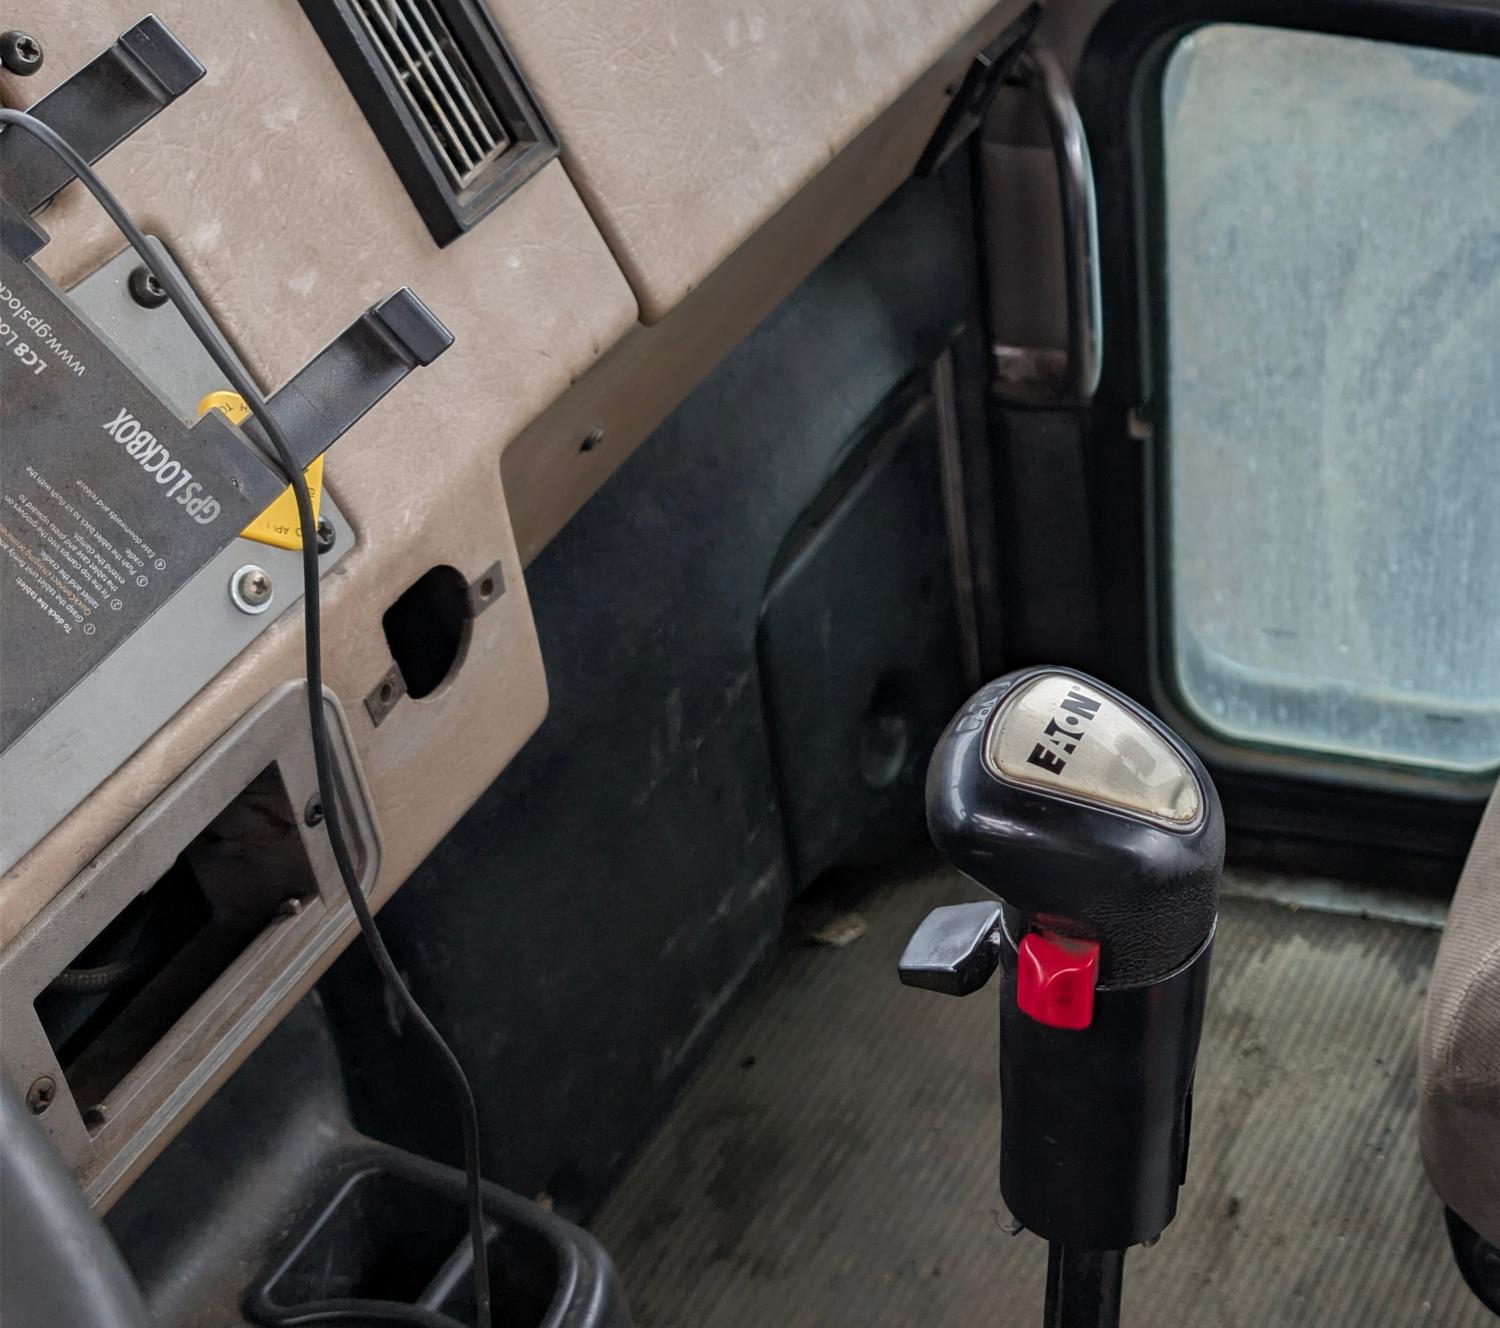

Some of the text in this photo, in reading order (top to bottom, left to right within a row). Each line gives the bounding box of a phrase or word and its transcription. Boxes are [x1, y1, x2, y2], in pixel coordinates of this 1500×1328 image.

[0, 317, 48, 375] LC8 Lo
[26, 465, 39, 479] the
[37, 476, 52, 491] with
[4, 494, 15, 505] on
[50, 489, 67, 506] flush
[95, 499, 111, 512] and
[13, 503, 38, 528] grooves
[64, 503, 74, 513] sit
[73, 511, 82, 520] to
[36, 526, 49, 539] the
[80, 518, 96, 535] back
[108, 510, 143, 545] downwards
[19, 494, 118, 592] the tablet case and press upward to
[47, 536, 61, 551] into
[93, 531, 113, 551] tablet
[7, 548, 27, 568] firmly
[59, 547, 82, 570] clamps
[110, 548, 123, 561] the
[141, 543, 156, 559] Ease
[94, 553, 106, 566] the
[121, 558, 137, 576] Push
[24, 564, 39, 579] unit
[58, 568, 71, 581] the
[80, 568, 93, 581] top
[103, 563, 126, 585] extend
[37, 576, 57, 596] tablet
[67, 578, 83, 592] and
[91, 579, 103, 591] the
[49, 574, 92, 616] QuickConnect
[55, 593, 67, 606] the
[80, 590, 99, 609] tablet
[100, 588, 111, 600] Fit
[15, 577, 72, 634] To dock the tablet:
[65, 603, 84, 623] Grasp
[1027, 690, 1103, 777] EATON
